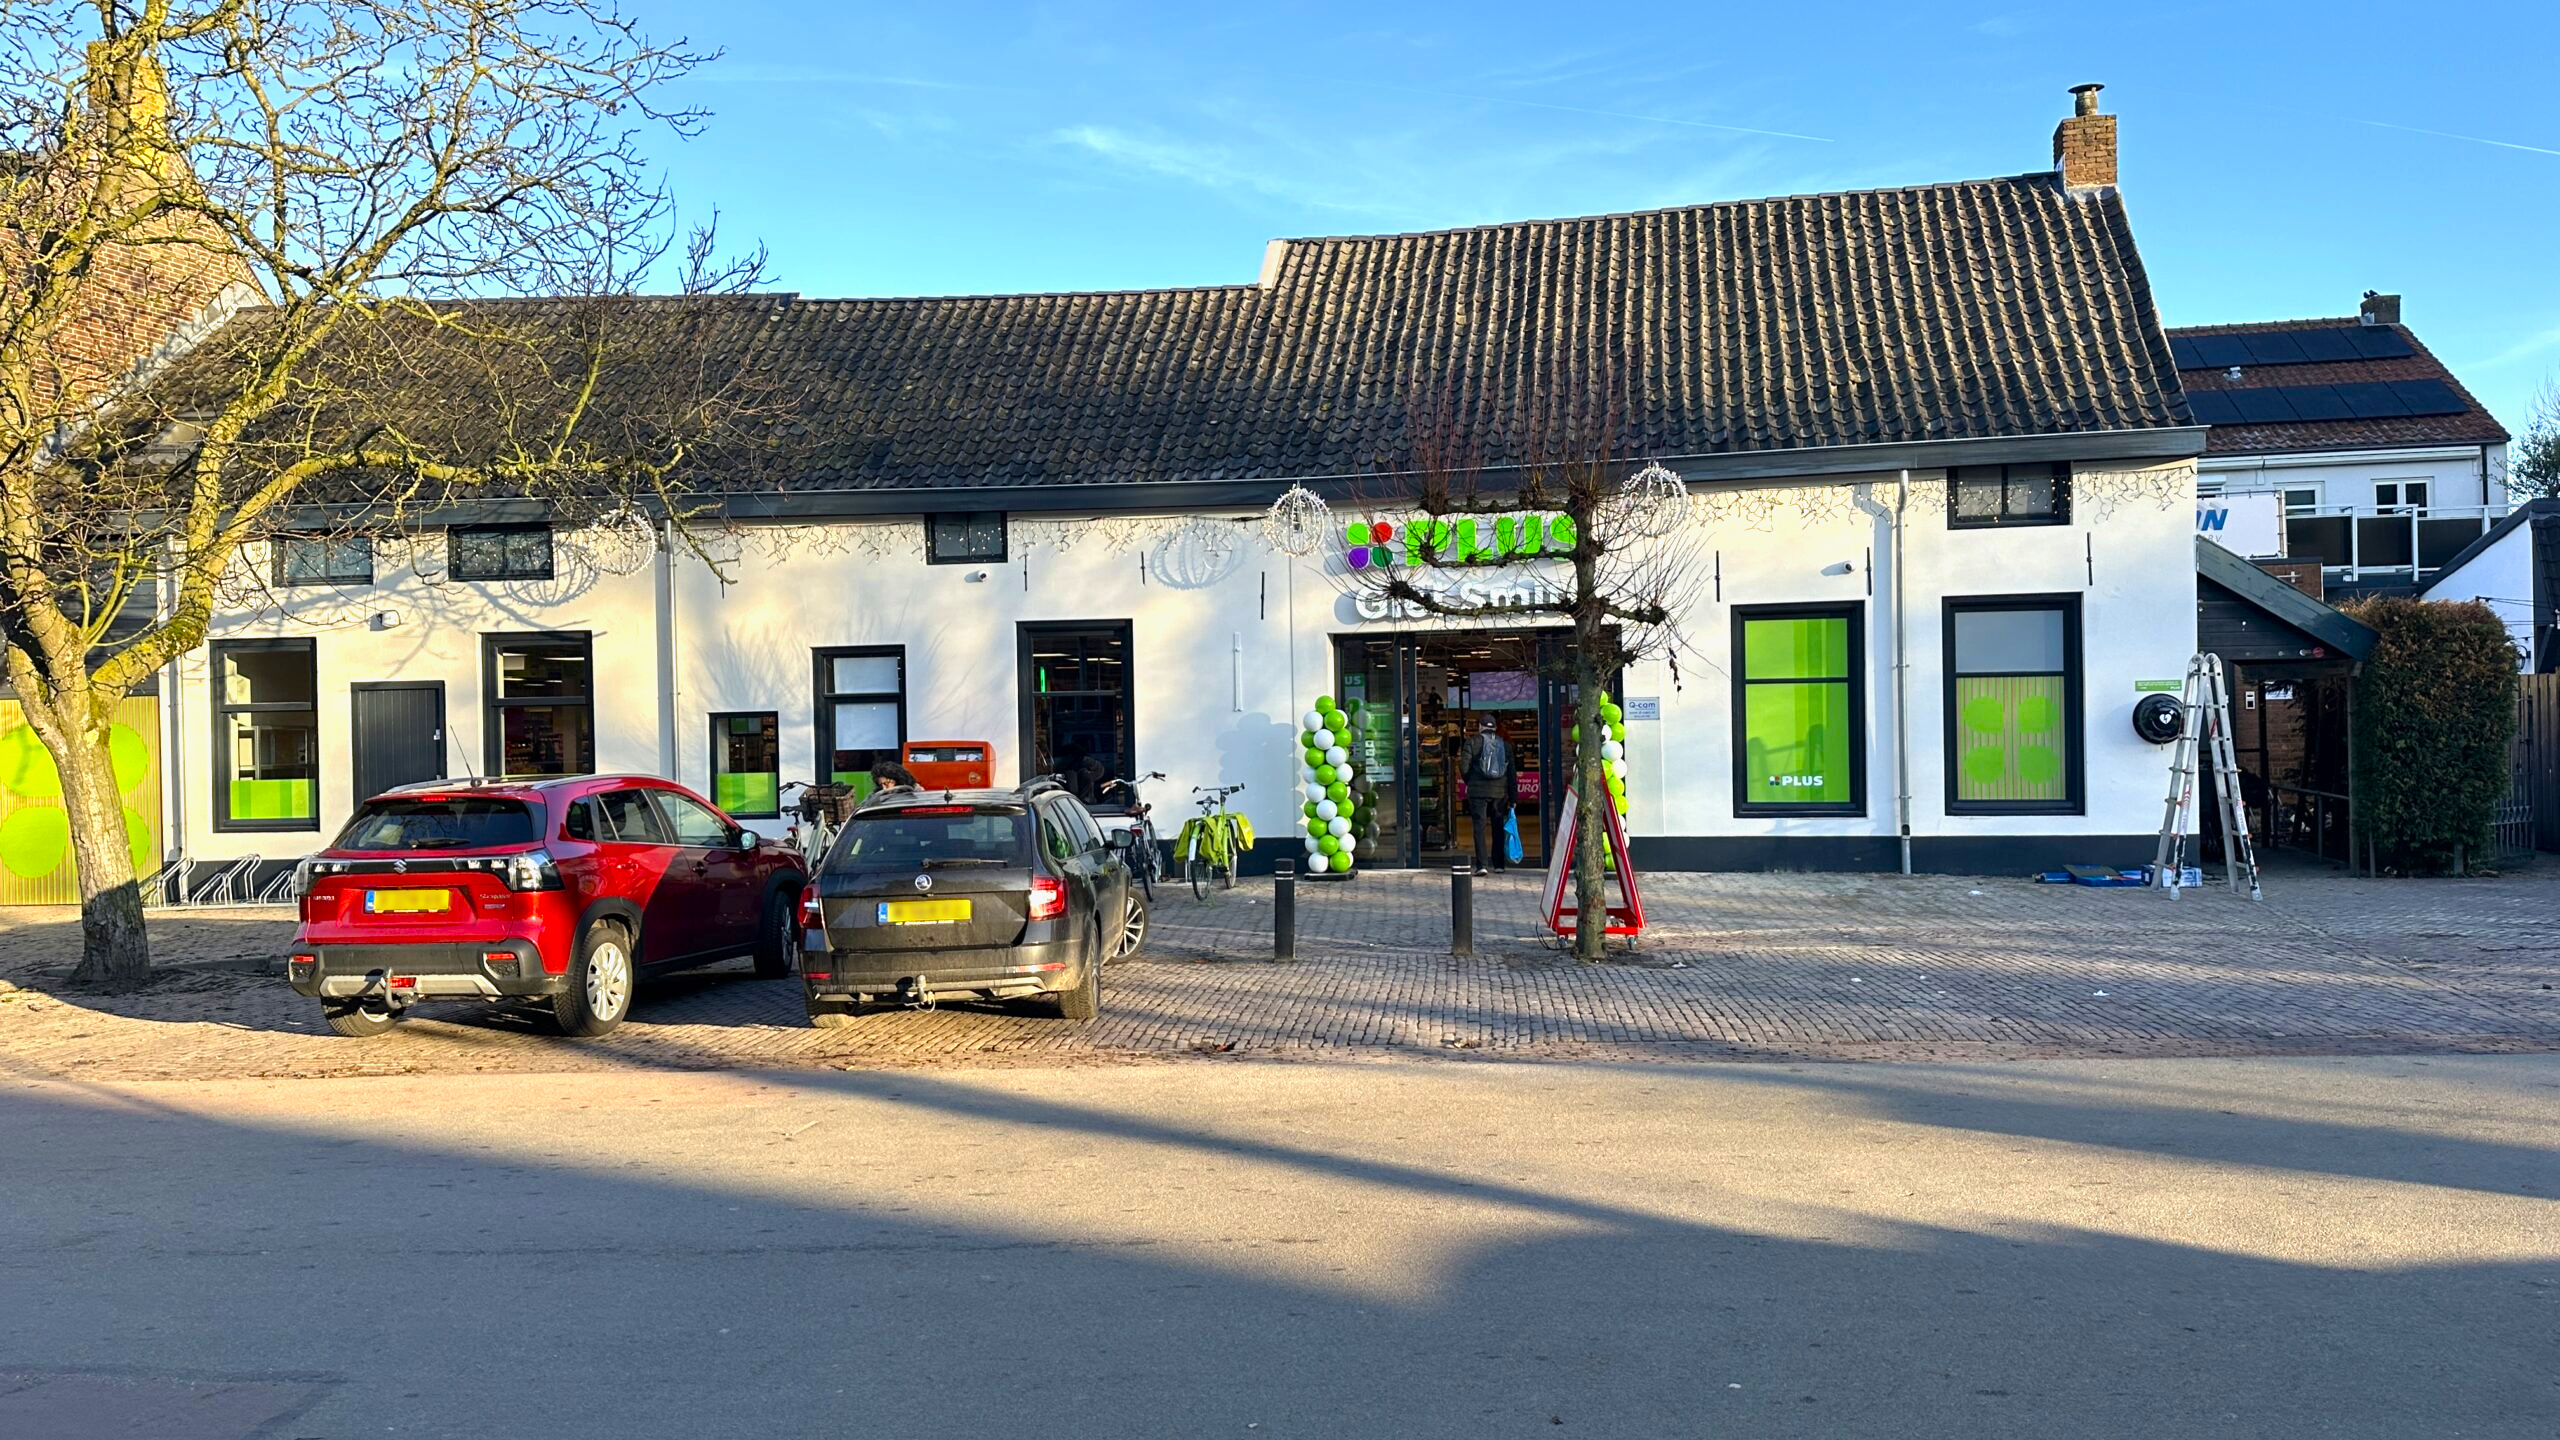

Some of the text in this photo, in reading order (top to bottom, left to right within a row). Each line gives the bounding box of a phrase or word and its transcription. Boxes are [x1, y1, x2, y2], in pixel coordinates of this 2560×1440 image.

[1404, 514, 1577, 567] PLUS
[1629, 701, 1656, 709] Q-cam
[1782, 775, 1823, 786] PLUS
[1517, 783, 1539, 793] URO
